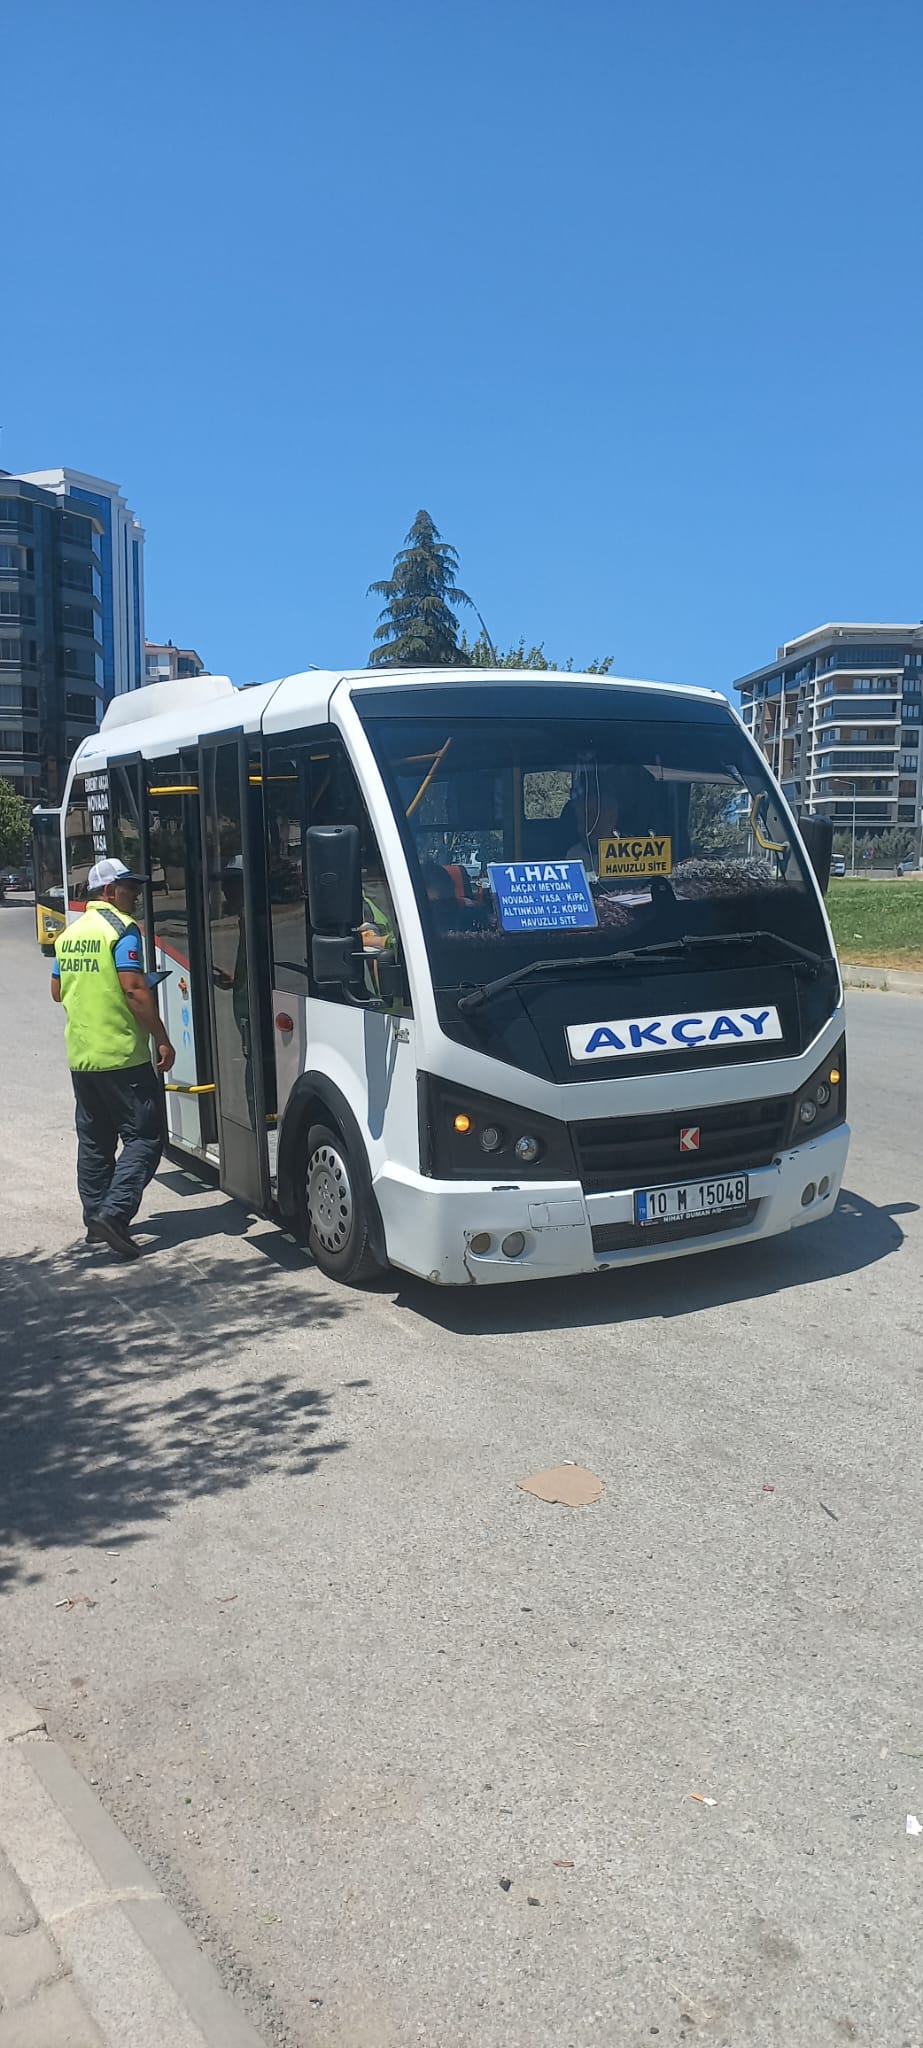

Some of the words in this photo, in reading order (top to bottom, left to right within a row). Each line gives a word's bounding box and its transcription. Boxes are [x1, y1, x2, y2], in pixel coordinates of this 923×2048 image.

[87, 794, 109, 812] NOVADA
[93, 835, 107, 851] YASA
[605, 841, 665, 861] AKÇAY
[505, 864, 569, 882] 1.HAT
[606, 863, 645, 873] HAVUZLU
[648, 861, 667, 872] SİTE
[511, 883, 537, 894] AKÇAY
[539, 882, 571, 891] MEYDAN
[502, 895, 534, 905] NOVADA
[540, 894, 560, 903] YASA
[567, 892, 585, 901] KİPA
[504, 906, 544, 917] ALTINKUM
[521, 917, 558, 927] HAVUZLU
[559, 915, 577, 925] SİTE
[61, 940, 101, 956] ULAŞIM
[60, 959, 100, 972] ZABITA
[585, 1011, 770, 1053] AKÇAY
[649, 1193, 667, 1215] 10
[677, 1189, 687, 1211] M
[698, 1180, 744, 1207] 15048
